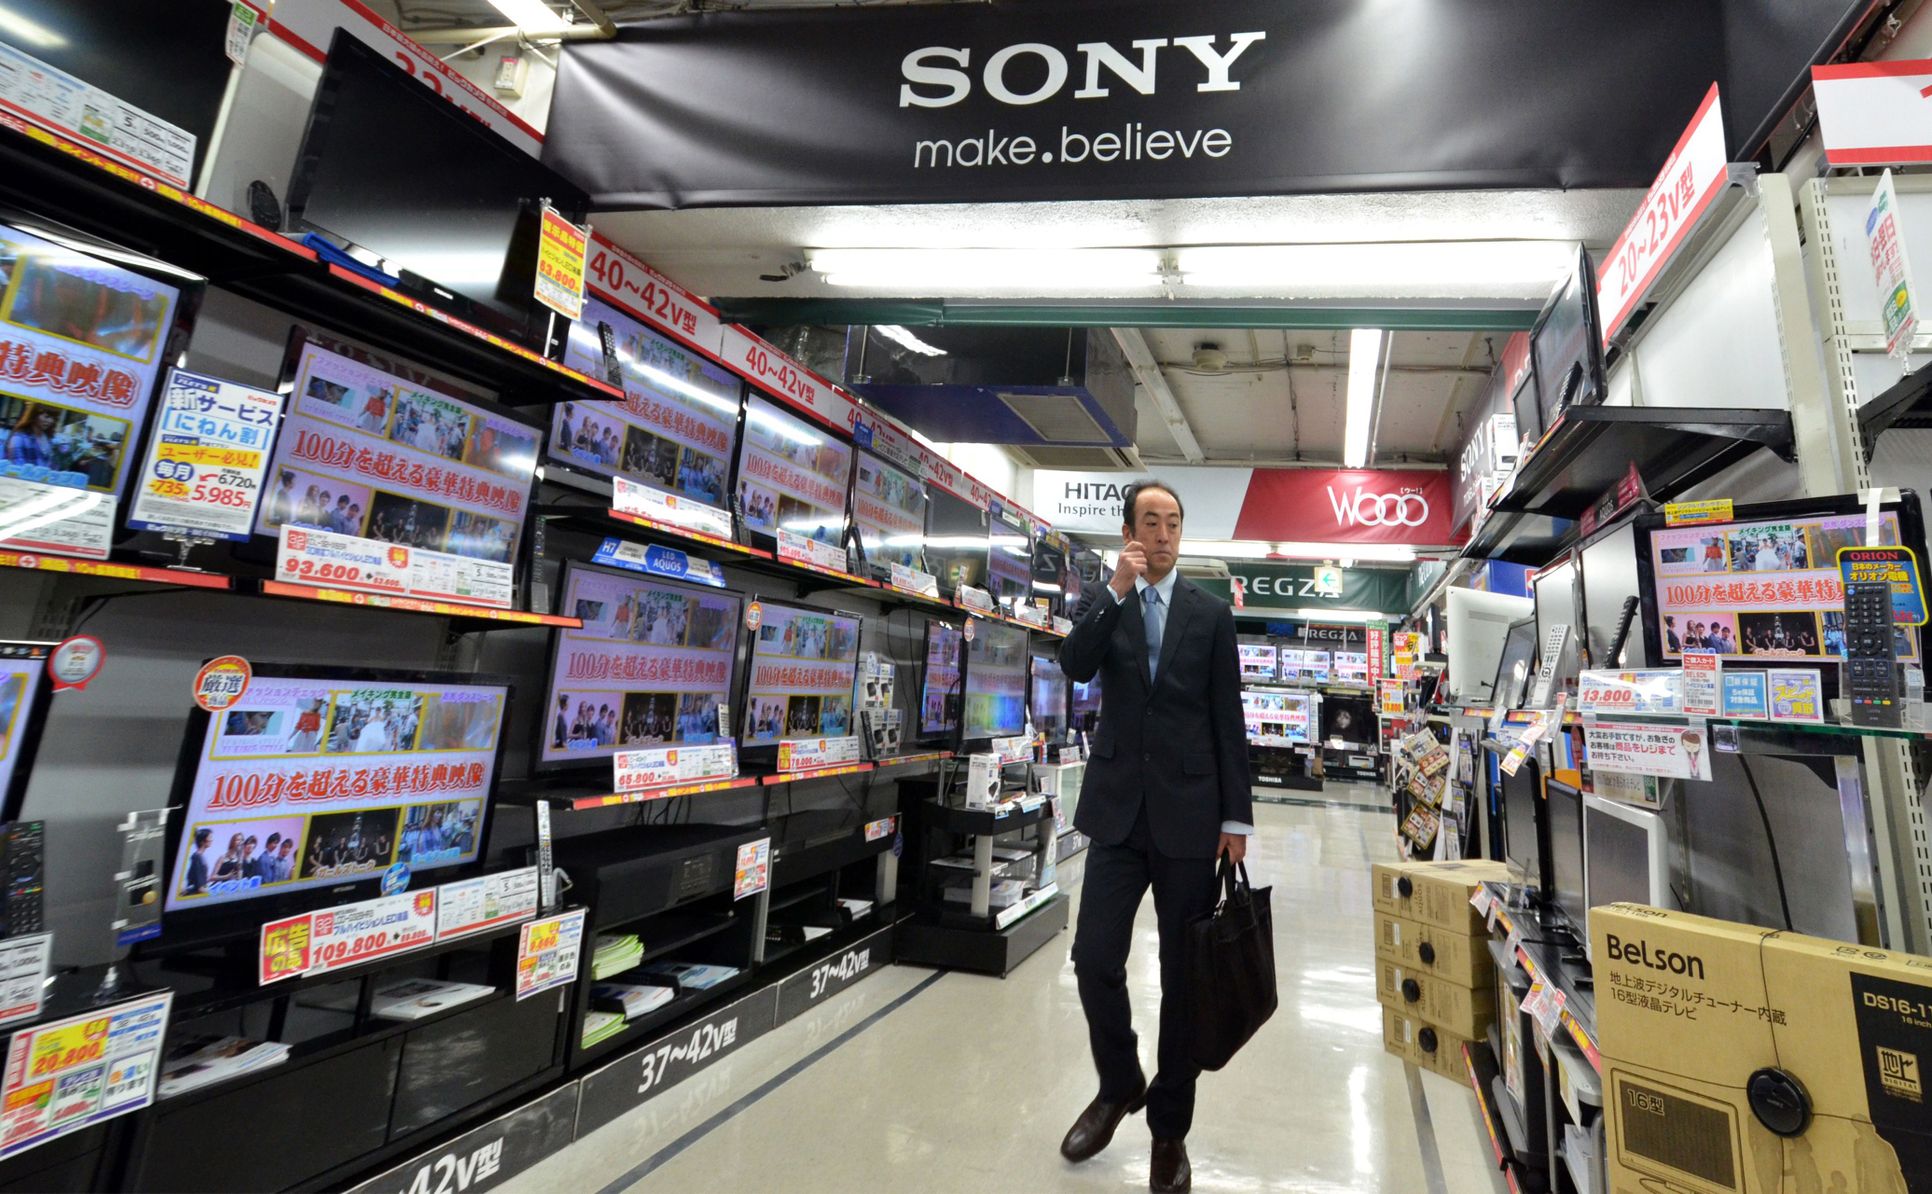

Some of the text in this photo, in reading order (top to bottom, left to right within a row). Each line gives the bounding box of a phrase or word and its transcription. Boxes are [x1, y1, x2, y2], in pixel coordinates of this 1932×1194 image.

[899, 31, 1266, 108] SONY
[914, 123, 1232, 168] make.believe
[590, 251, 697, 336] 40~42V型
[746, 346, 815, 406] 40~42V型
[170, 387, 273, 426] 新サービス
[290, 430, 522, 513] 100分を超える豪華特典映像
[1058, 503, 1106, 518] Inspire
[653, 559, 682, 572] AQUOS
[1850, 551, 1899, 561] ORION
[1230, 575, 1340, 599] REGZ
[1308, 630, 1358, 641] REGZA
[566, 652, 727, 684] 100分を超える豪華特典映像
[1590, 742, 1677, 756] お客様は商品をレジまで
[1591, 752, 1635, 762] お待ち下さい。
[207, 761, 486, 812] 100分を超える豪華特典映像
[265, 922, 310, 957] 広告
[313, 931, 388, 964] 109,800
[1606, 933, 1705, 980] Belson
[811, 949, 870, 999] 37~42V型
[1609, 971, 1787, 1027] 地上波デジタルチューナー内蔵
[1611, 989, 1699, 1021] 16型液晶テレビ
[637, 1017, 738, 1094] 37~42V型
[1884, 1077, 1918, 1090] DIGITAL
[1627, 1088, 1665, 1117] 16型
[399, 1136, 504, 1194] 42V型
